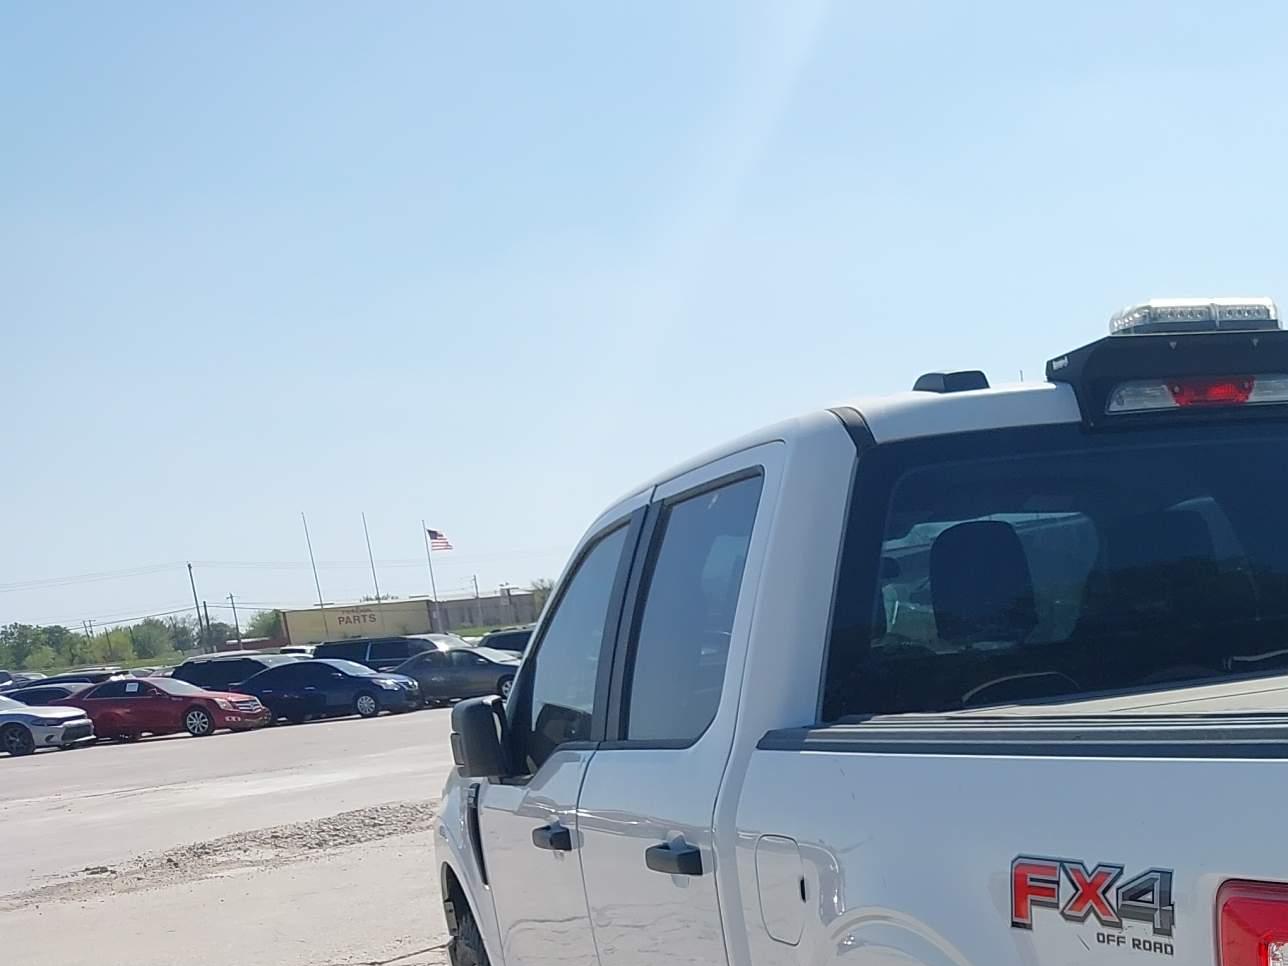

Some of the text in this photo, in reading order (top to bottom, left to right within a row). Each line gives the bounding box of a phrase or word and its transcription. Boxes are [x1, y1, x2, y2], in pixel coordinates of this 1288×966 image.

[337, 613, 377, 625] PARTS
[1010, 855, 1175, 936] FX4
[1096, 932, 1175, 956] OFF ROAD
